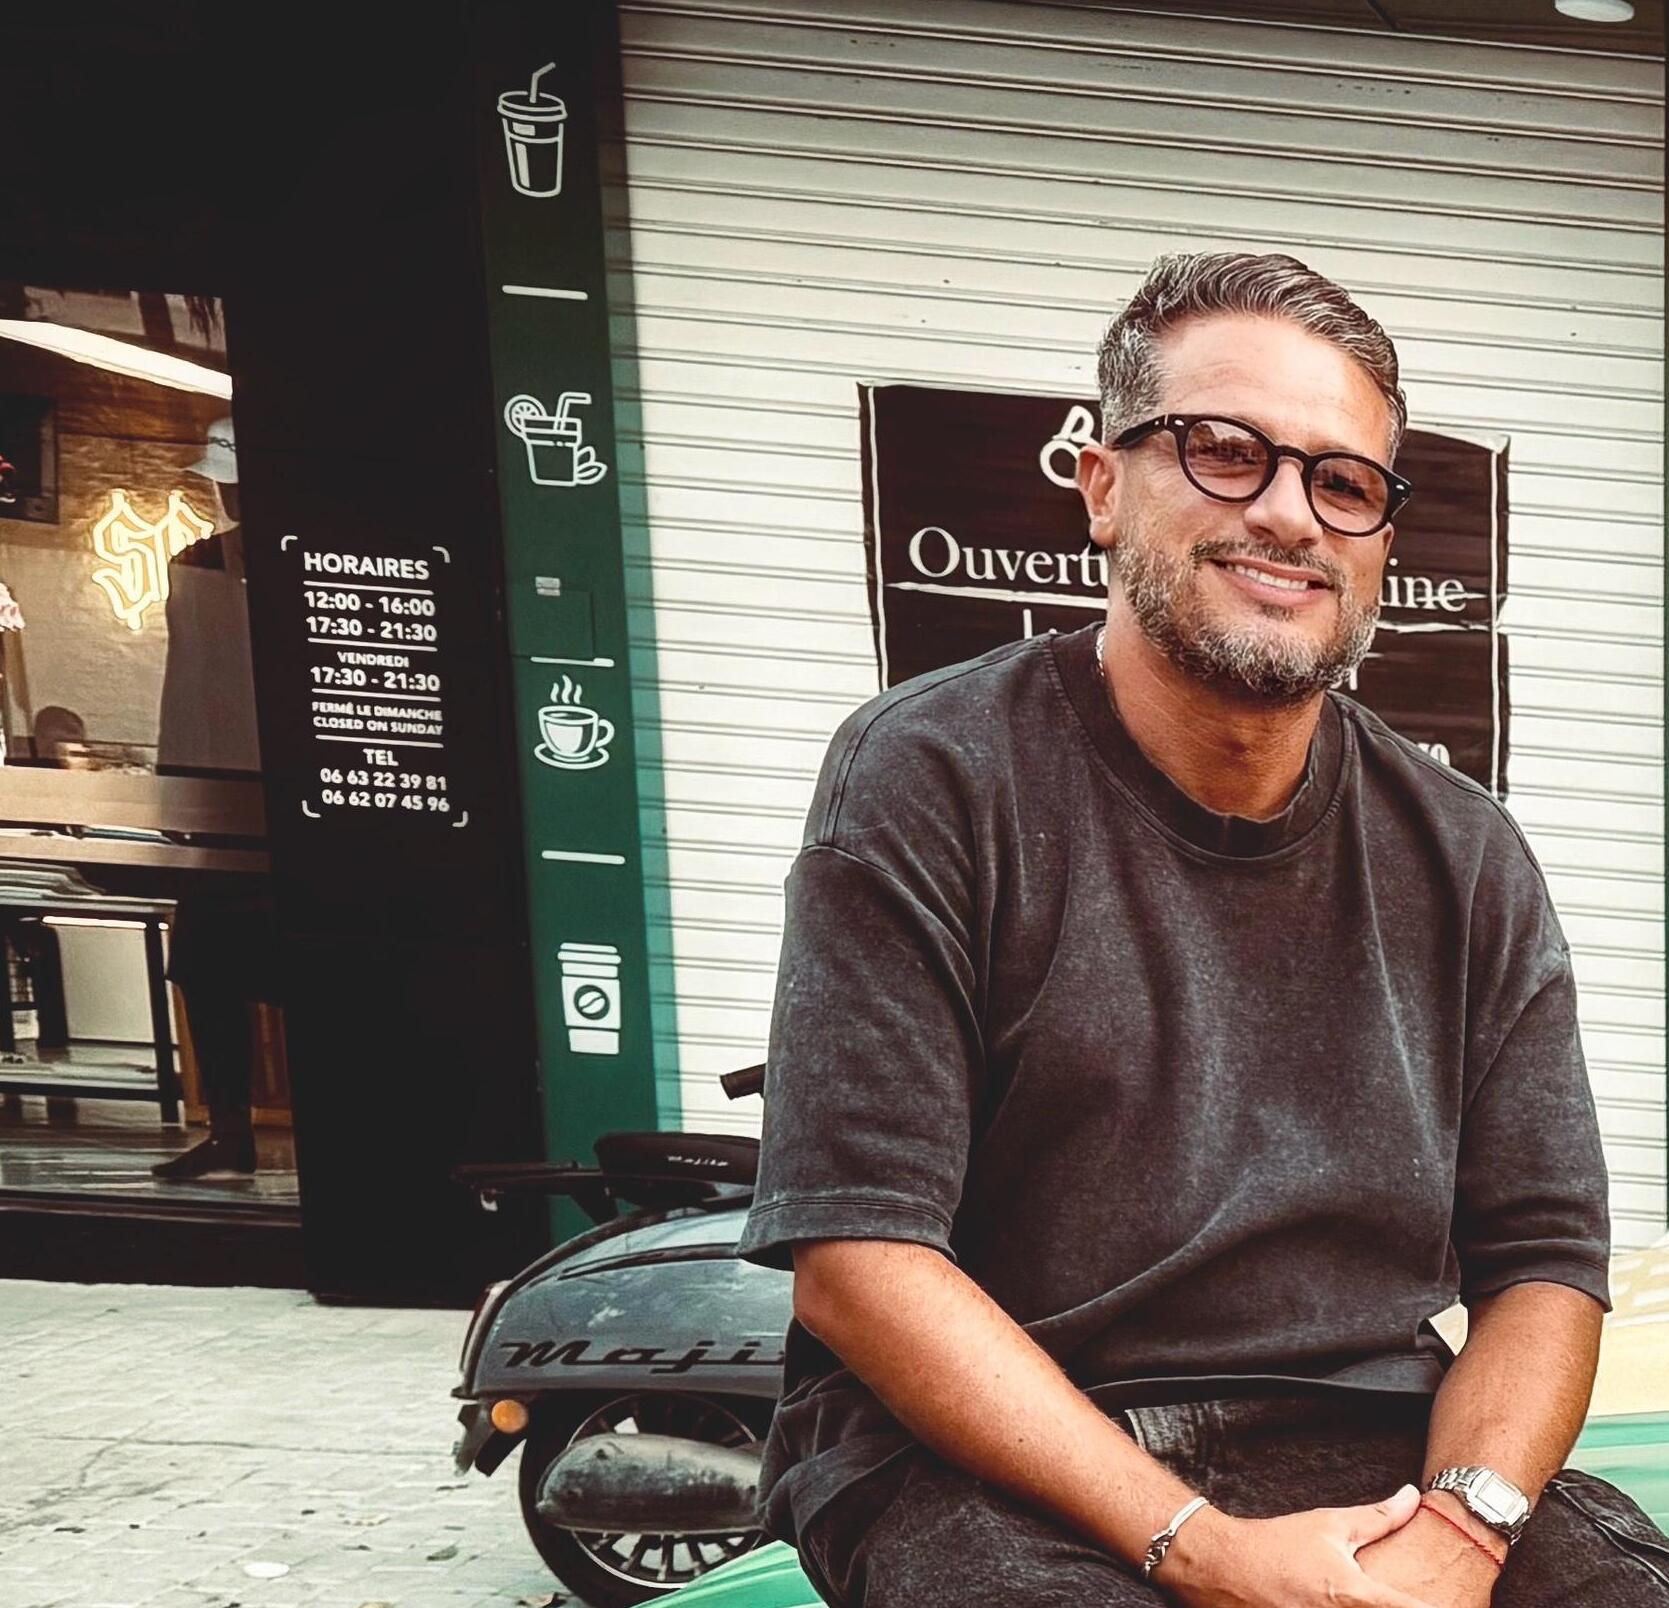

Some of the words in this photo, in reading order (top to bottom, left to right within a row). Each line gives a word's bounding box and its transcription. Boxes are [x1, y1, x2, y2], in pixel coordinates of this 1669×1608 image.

[303, 551, 430, 580] HORAIRES
[1379, 557, 1467, 612] ine
[303, 590, 361, 611] 12:00
[378, 595, 436, 617] 16:00
[306, 615, 363, 636] 17:30
[379, 620, 437, 642] 21:30
[336, 651, 410, 668] VENDREDI
[310, 666, 367, 687] 17:30
[383, 671, 441, 692] 21:30
[311, 701, 354, 715] FERMÉ
[356, 704, 372, 716] LE
[373, 705, 443, 721] DIMANCHE
[312, 716, 364, 730] CLOSED
[366, 720, 388, 732] ON
[390, 721, 443, 735] SUNDAY
[362, 748, 399, 767] TEL
[319, 767, 344, 784] 06
[346, 769, 370, 786] 63
[372, 771, 396, 788] 22
[399, 773, 422, 789] 39
[425, 775, 447, 791] 81
[321, 789, 345, 805] 06
[348, 791, 371, 807] 62
[374, 792, 398, 808] 07
[401, 794, 423, 811] 45
[426, 796, 450, 812] 96
[500, 1339, 785, 1374] Maji
